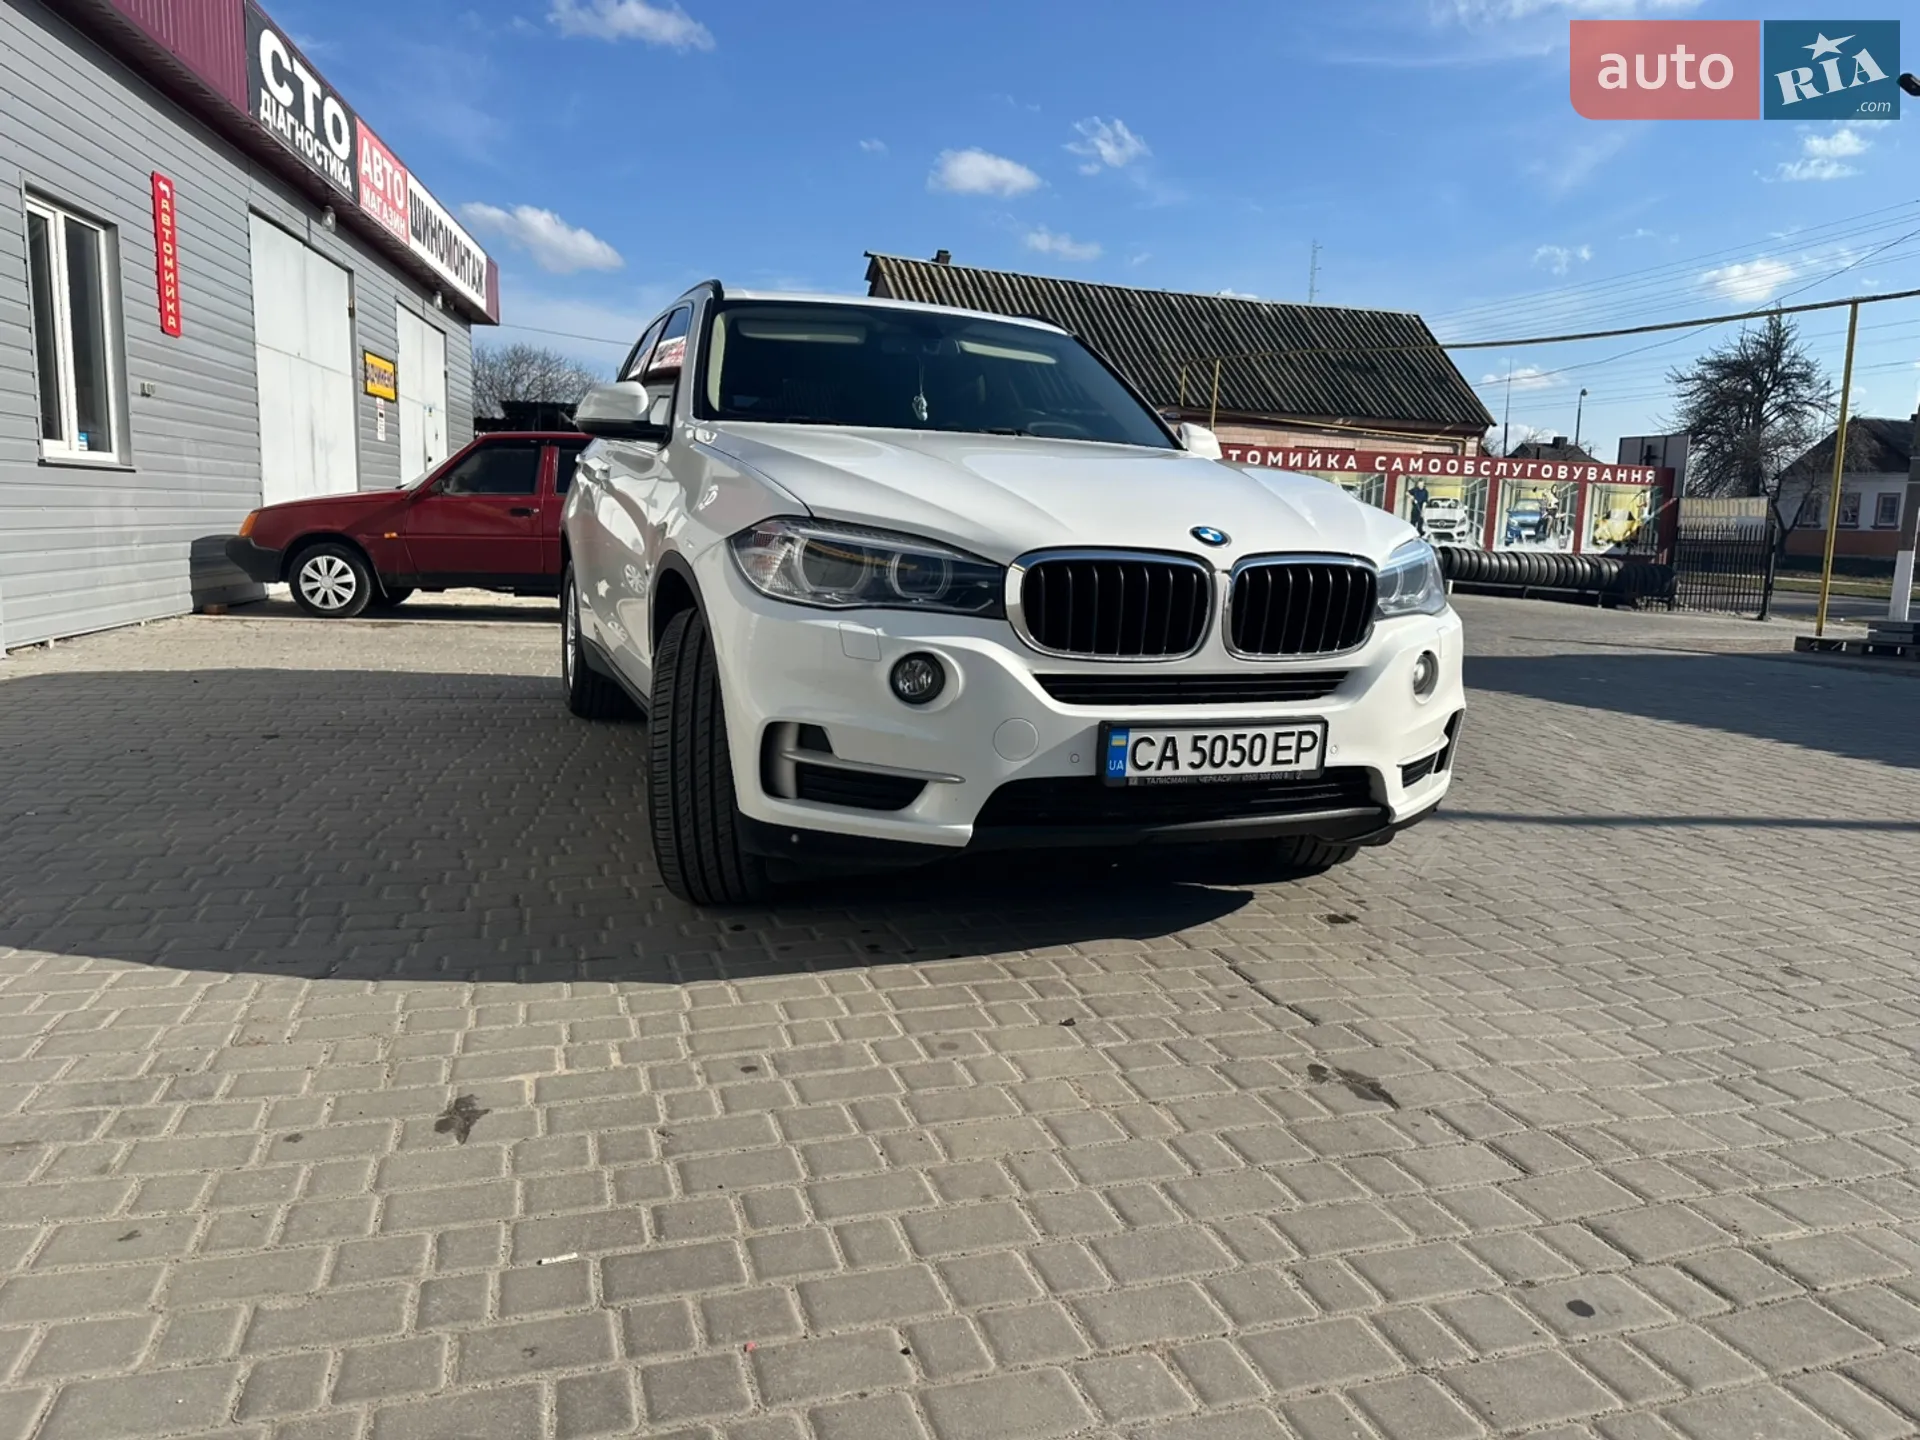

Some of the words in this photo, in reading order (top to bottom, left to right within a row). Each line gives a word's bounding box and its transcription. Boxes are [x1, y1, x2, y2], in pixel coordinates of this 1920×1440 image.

[259, 28, 350, 160] СТО
[259, 87, 353, 192] ДІАГНОСТИКА
[360, 136, 405, 210] АВТО
[362, 182, 406, 238] МАГАЗИН
[408, 187, 485, 300] ШИНОМОНТАЖ
[161, 197, 177, 329] АВТОМИЙКА
[1374, 455, 1657, 484] САМООБСЛУГОВУВАННЯ
[1109, 760, 1124, 771] UA
[1131, 735, 1180, 771] CA
[1187, 733, 1267, 770] 5050
[1271, 730, 1318, 766] EP
